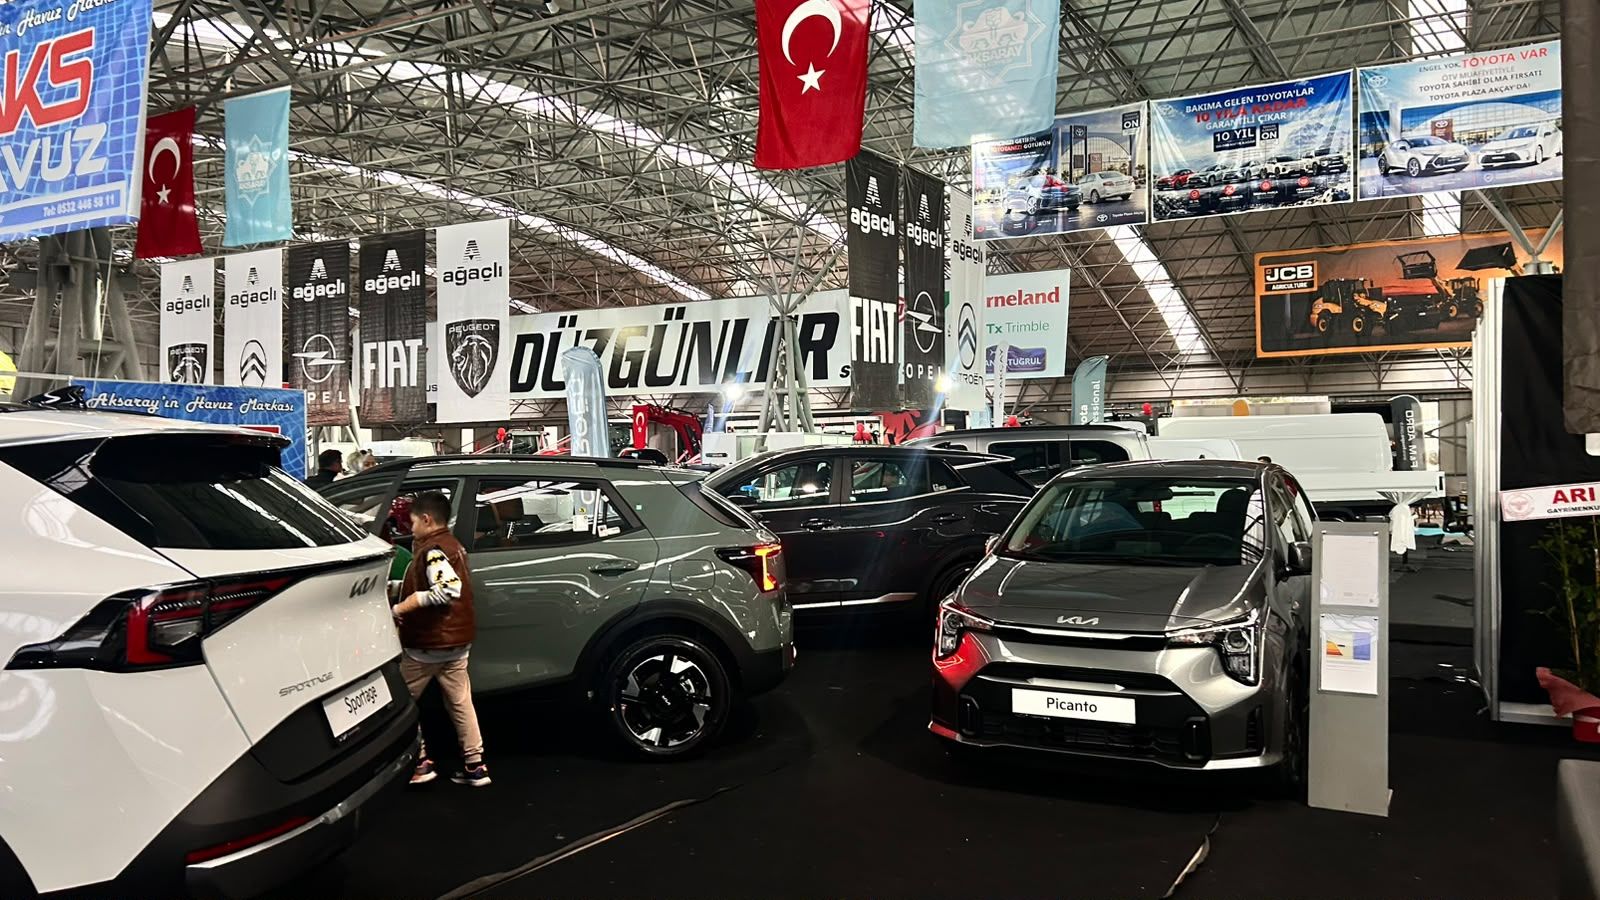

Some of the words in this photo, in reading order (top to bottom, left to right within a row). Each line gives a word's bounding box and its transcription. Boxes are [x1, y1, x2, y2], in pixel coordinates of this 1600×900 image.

[17, 8, 62, 37] Havuz
[1419, 64, 1442, 73] ENGEL
[1461, 53, 1516, 69] TOYOTA
[1520, 47, 1548, 60] VAR
[0, 26, 95, 137] KS
[1419, 83, 1451, 92] TOYOTA
[1452, 78, 1481, 88] SAHİBİ
[1483, 75, 1509, 84] OLMA
[1510, 69, 1542, 80] FIRSATI
[1185, 101, 1222, 113] BAKIMA
[1224, 95, 1254, 107] GELEN
[1256, 87, 1315, 103] TOYOTA'LAR
[1429, 92, 1460, 101] TOYOTA
[1462, 89, 1487, 97] PLAZA
[1123, 119, 1139, 129] ON
[1195, 112, 1210, 123] 10
[1258, 111, 1287, 124] ÇIKAR
[1215, 131, 1230, 142] 10
[1234, 127, 1255, 139] YIL
[1261, 131, 1277, 140] ON
[850, 206, 895, 237] ağaçlı
[906, 221, 942, 250] ağaçlı
[953, 239, 983, 264] ağaçlı
[364, 270, 421, 295] ağaçlı
[442, 262, 503, 286] ağaçlı
[1265, 265, 1313, 282] JCB
[230, 286, 277, 308] ağaçlı
[292, 278, 345, 302] ağaçlı
[1271, 282, 1308, 290] AGRICULTURE
[166, 294, 210, 314] ağaçlı
[448, 323, 497, 334] PEUGEOT
[849, 296, 898, 364] FIAT
[986, 324, 1003, 335] Tx
[1005, 320, 1050, 334] Trimble
[169, 346, 206, 356] PEUGEOT
[510, 306, 840, 393] DÜZGÜNLR
[363, 338, 423, 389] FIAT
[185, 396, 233, 413] Havuz
[239, 397, 294, 414] Markası
[307, 390, 346, 404] PEL
[1552, 487, 1596, 504] ARI
[349, 575, 379, 599] KIA
[1056, 615, 1099, 625] KIA
[279, 671, 335, 697] SPORTAGE
[344, 685, 378, 716] Sportage
[1046, 697, 1098, 714] Picanto
